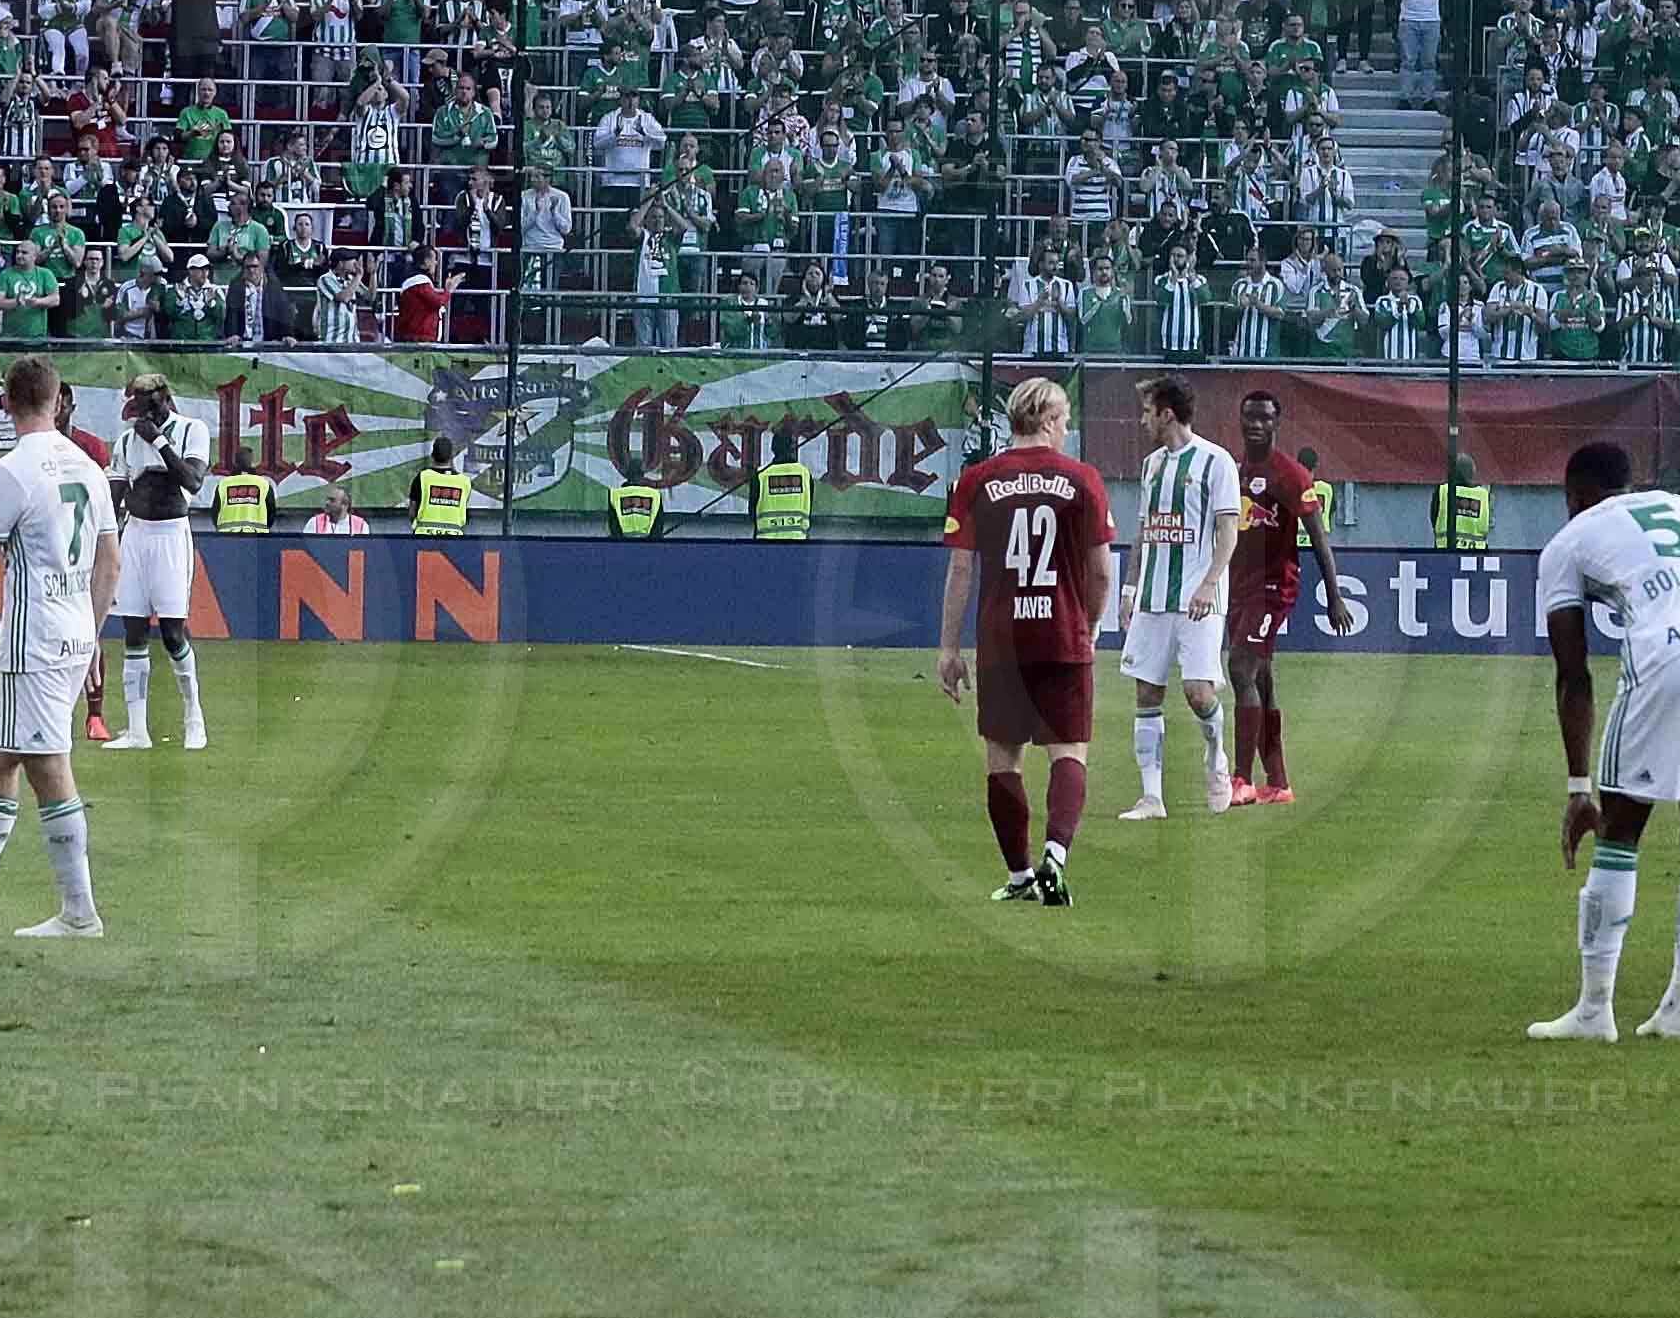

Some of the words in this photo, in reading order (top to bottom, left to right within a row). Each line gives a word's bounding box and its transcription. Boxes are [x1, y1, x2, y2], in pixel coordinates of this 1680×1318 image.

[607, 380, 947, 493] Garde
[58, 482, 91, 566] 7
[1005, 507, 1057, 587] 42
[1258, 614, 1272, 638] 8
